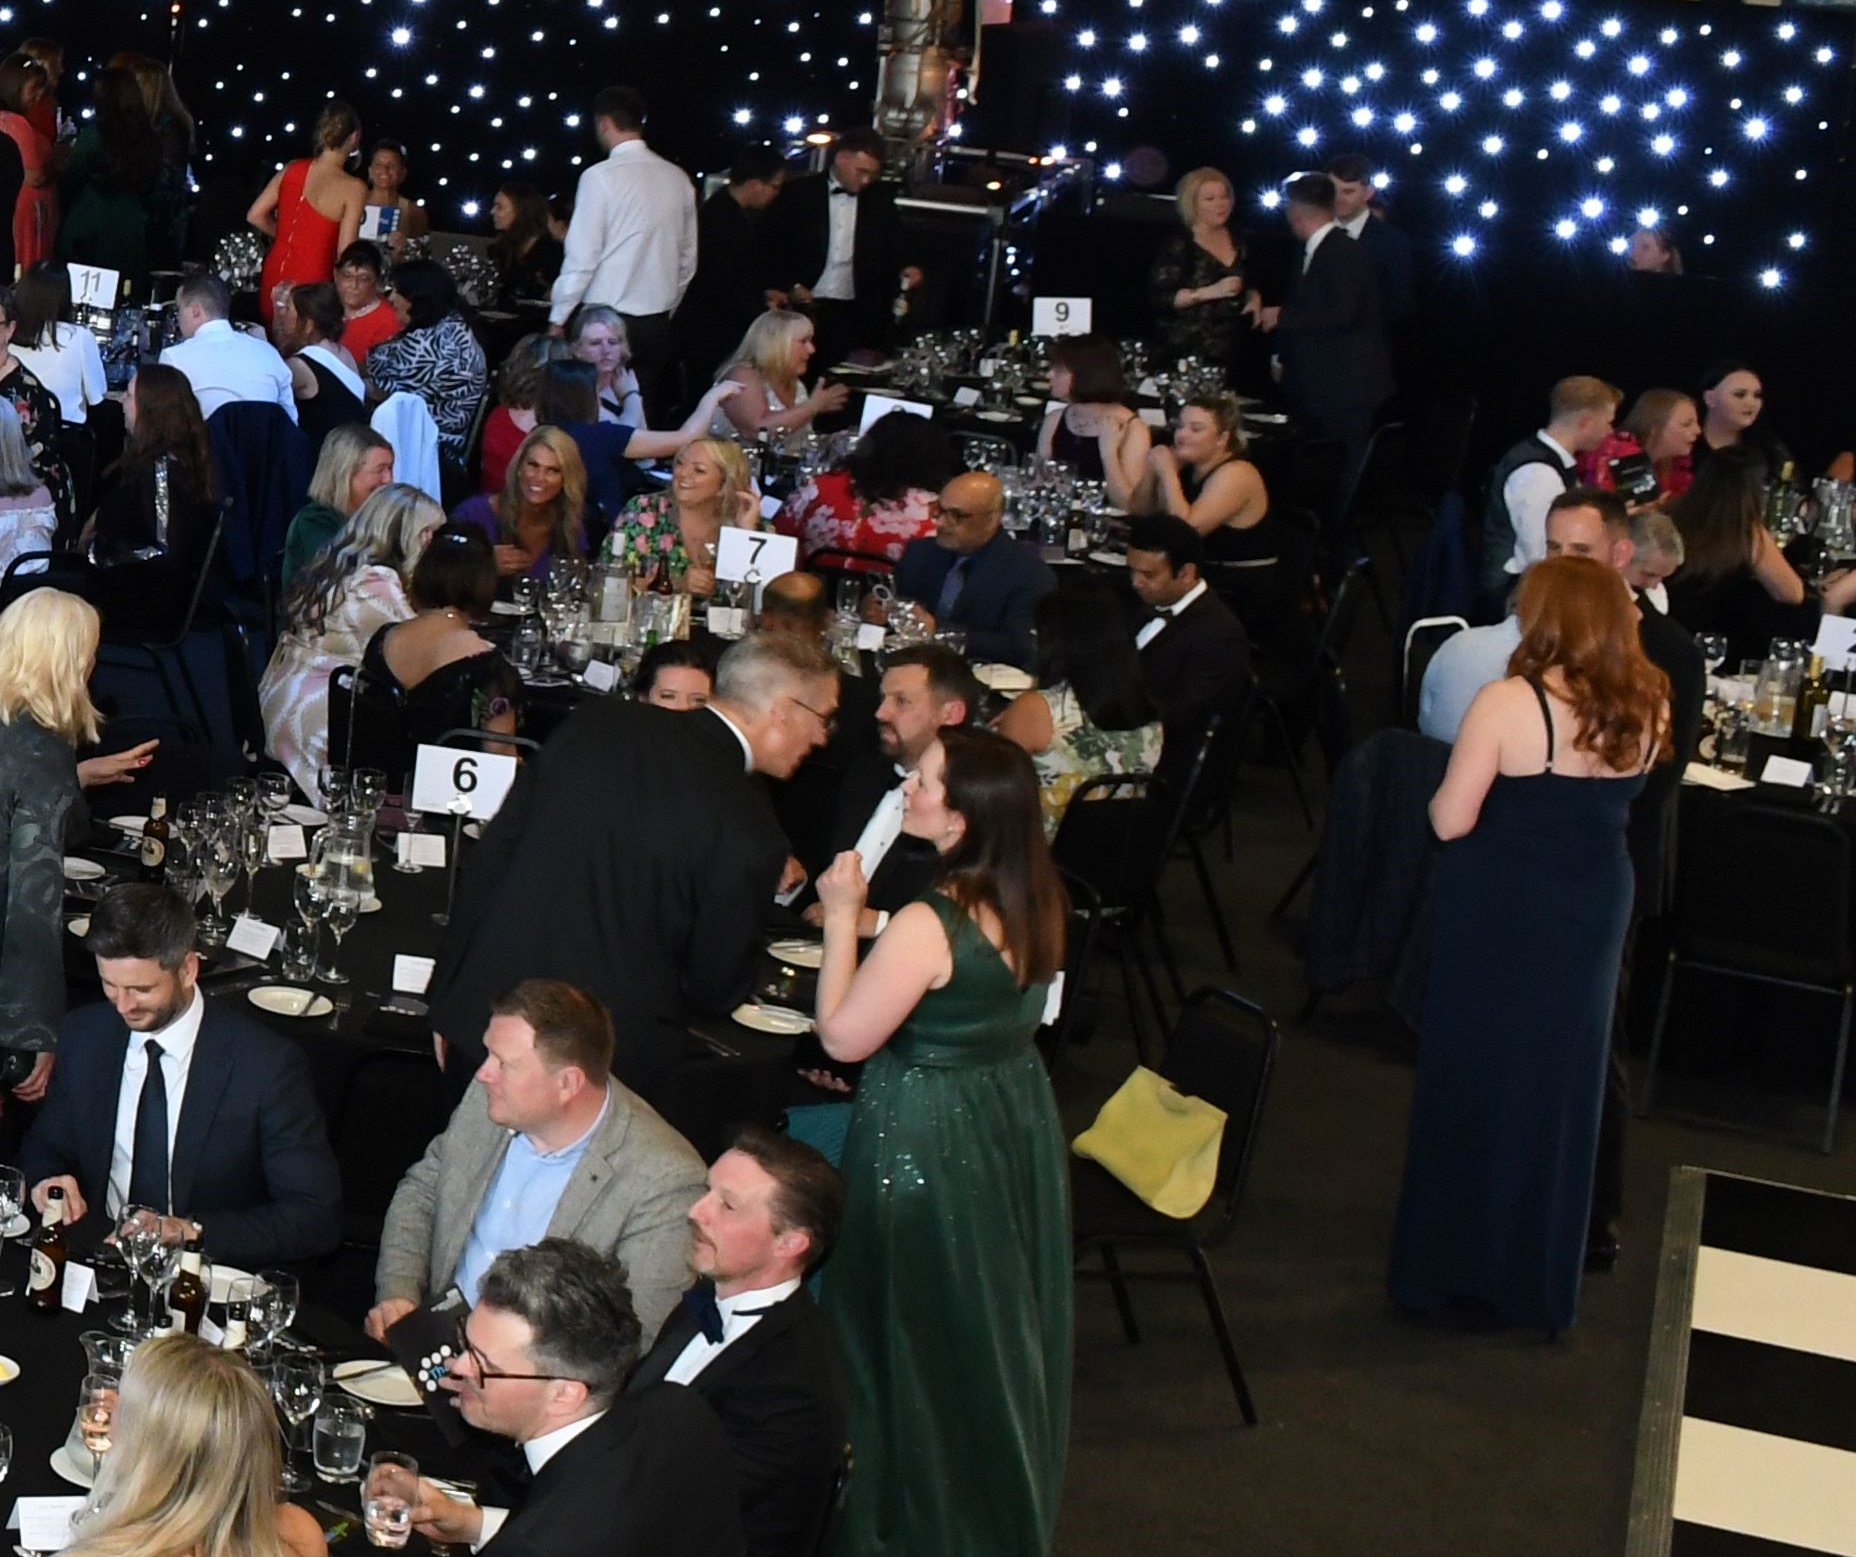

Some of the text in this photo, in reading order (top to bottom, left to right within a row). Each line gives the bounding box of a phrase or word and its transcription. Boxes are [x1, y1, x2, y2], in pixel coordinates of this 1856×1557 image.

[80, 269, 102, 293] 11
[1055, 301, 1070, 323] 9
[748, 537, 768, 564] 7
[452, 757, 478, 794] 6
